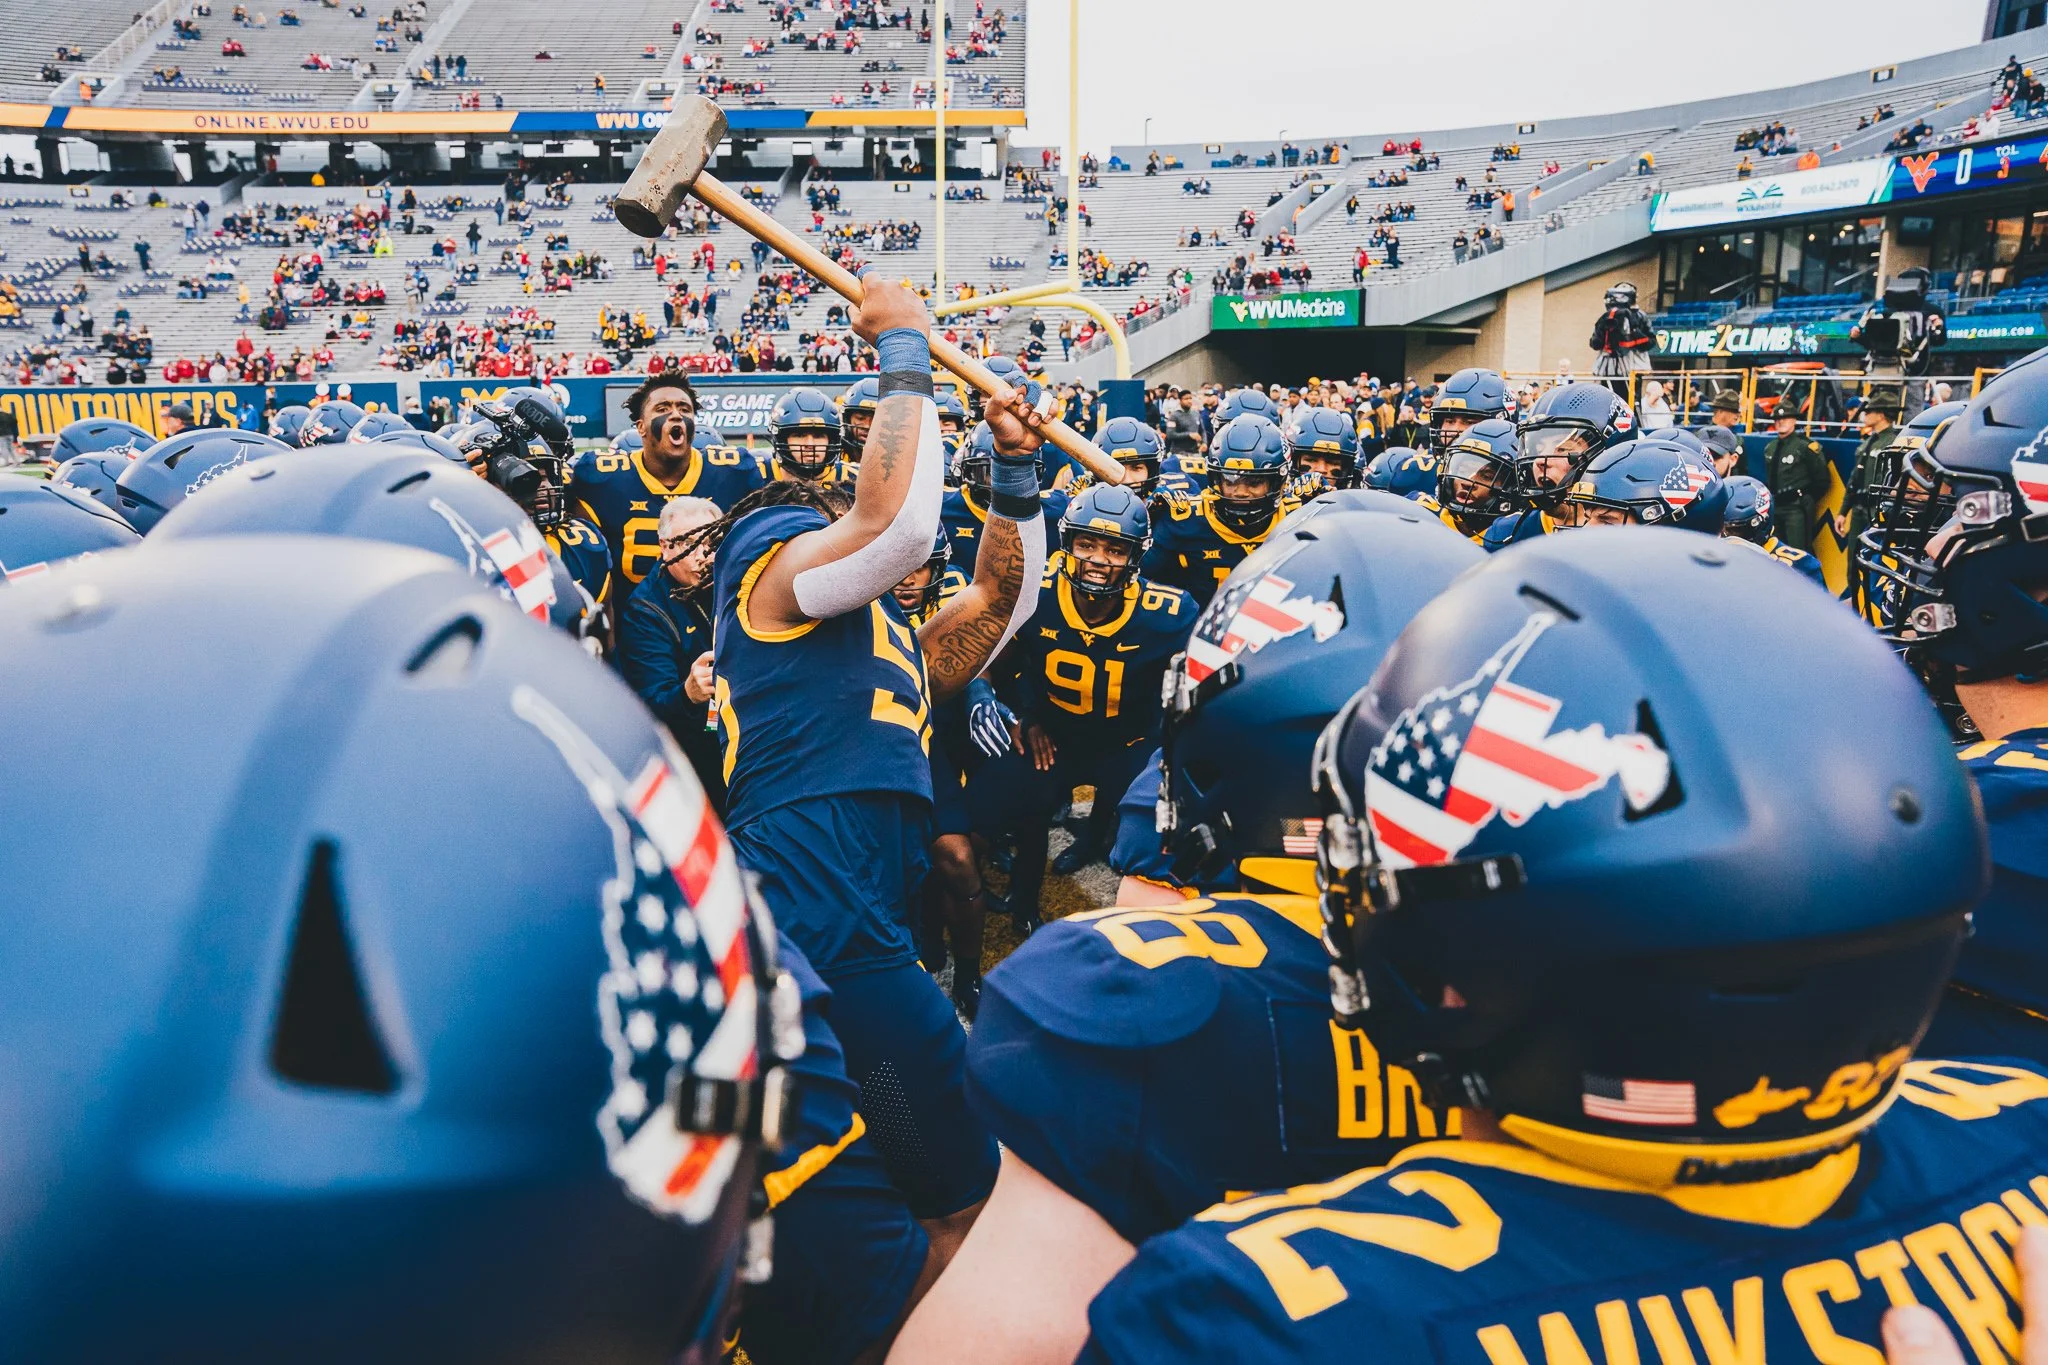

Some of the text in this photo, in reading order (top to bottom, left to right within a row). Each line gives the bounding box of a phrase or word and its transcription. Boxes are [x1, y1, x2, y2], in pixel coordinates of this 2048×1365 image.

[194, 115, 369, 129] ONLINE.WVU.EDU
[595, 112, 639, 129] WVU
[1995, 144, 2020, 158] TOL
[1955, 148, 1973, 185] 0
[1248, 298, 1345, 319] WVUMedicine
[1670, 324, 1793, 357] TIME2CLIMB
[721, 394, 776, 411] GAME
[1044, 648, 1125, 719] 91
[1328, 1018, 1463, 1139] BR
